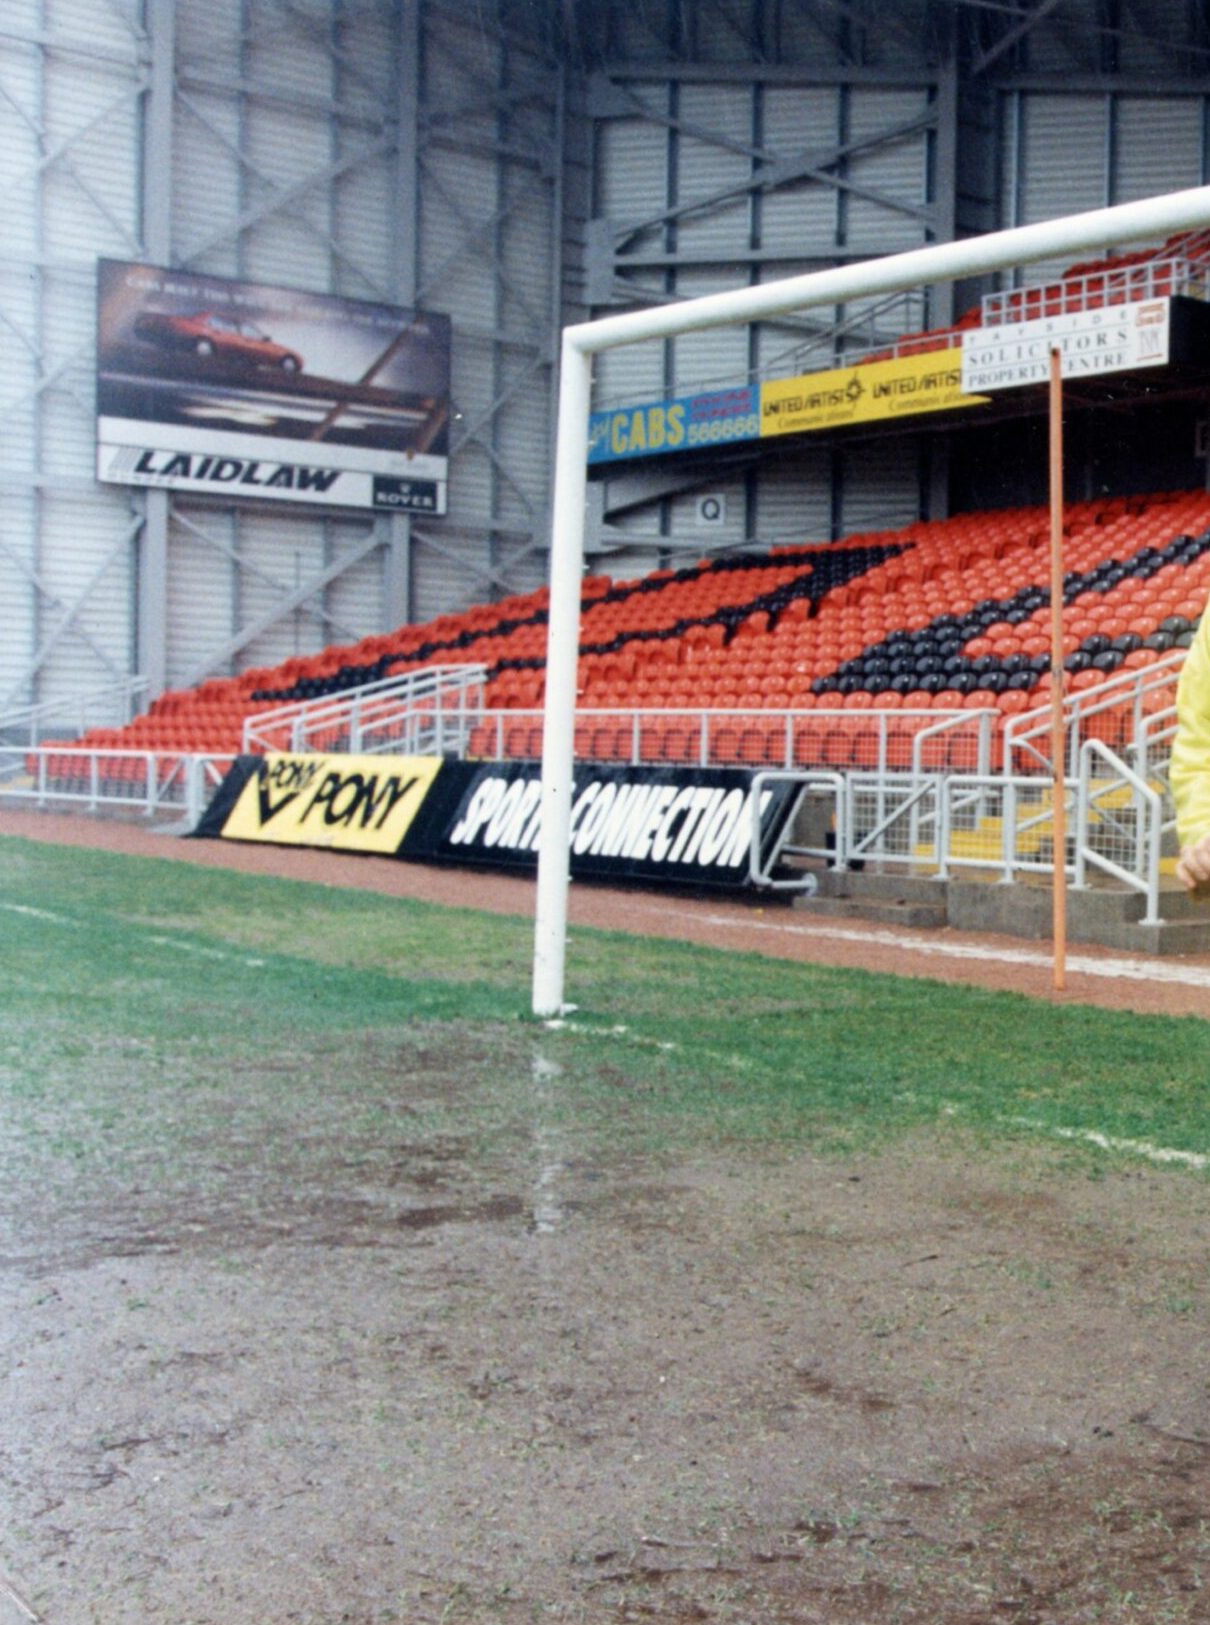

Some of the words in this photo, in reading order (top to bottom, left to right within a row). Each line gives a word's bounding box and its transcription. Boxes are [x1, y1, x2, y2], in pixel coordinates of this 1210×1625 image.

[969, 329, 1128, 366] SOLICITORS
[872, 375, 917, 399] UNITED
[968, 364, 1048, 388] PROPERTY
[1067, 352, 1128, 372] ENTRE
[763, 395, 804, 417] UNITED
[611, 404, 685, 454] CABS
[133, 451, 342, 493] LAIDLAW
[376, 492, 434, 507] ROVER
[701, 498, 720, 521] Q
[298, 772, 419, 831] PONY
[567, 781, 774, 868] CONNECTION
